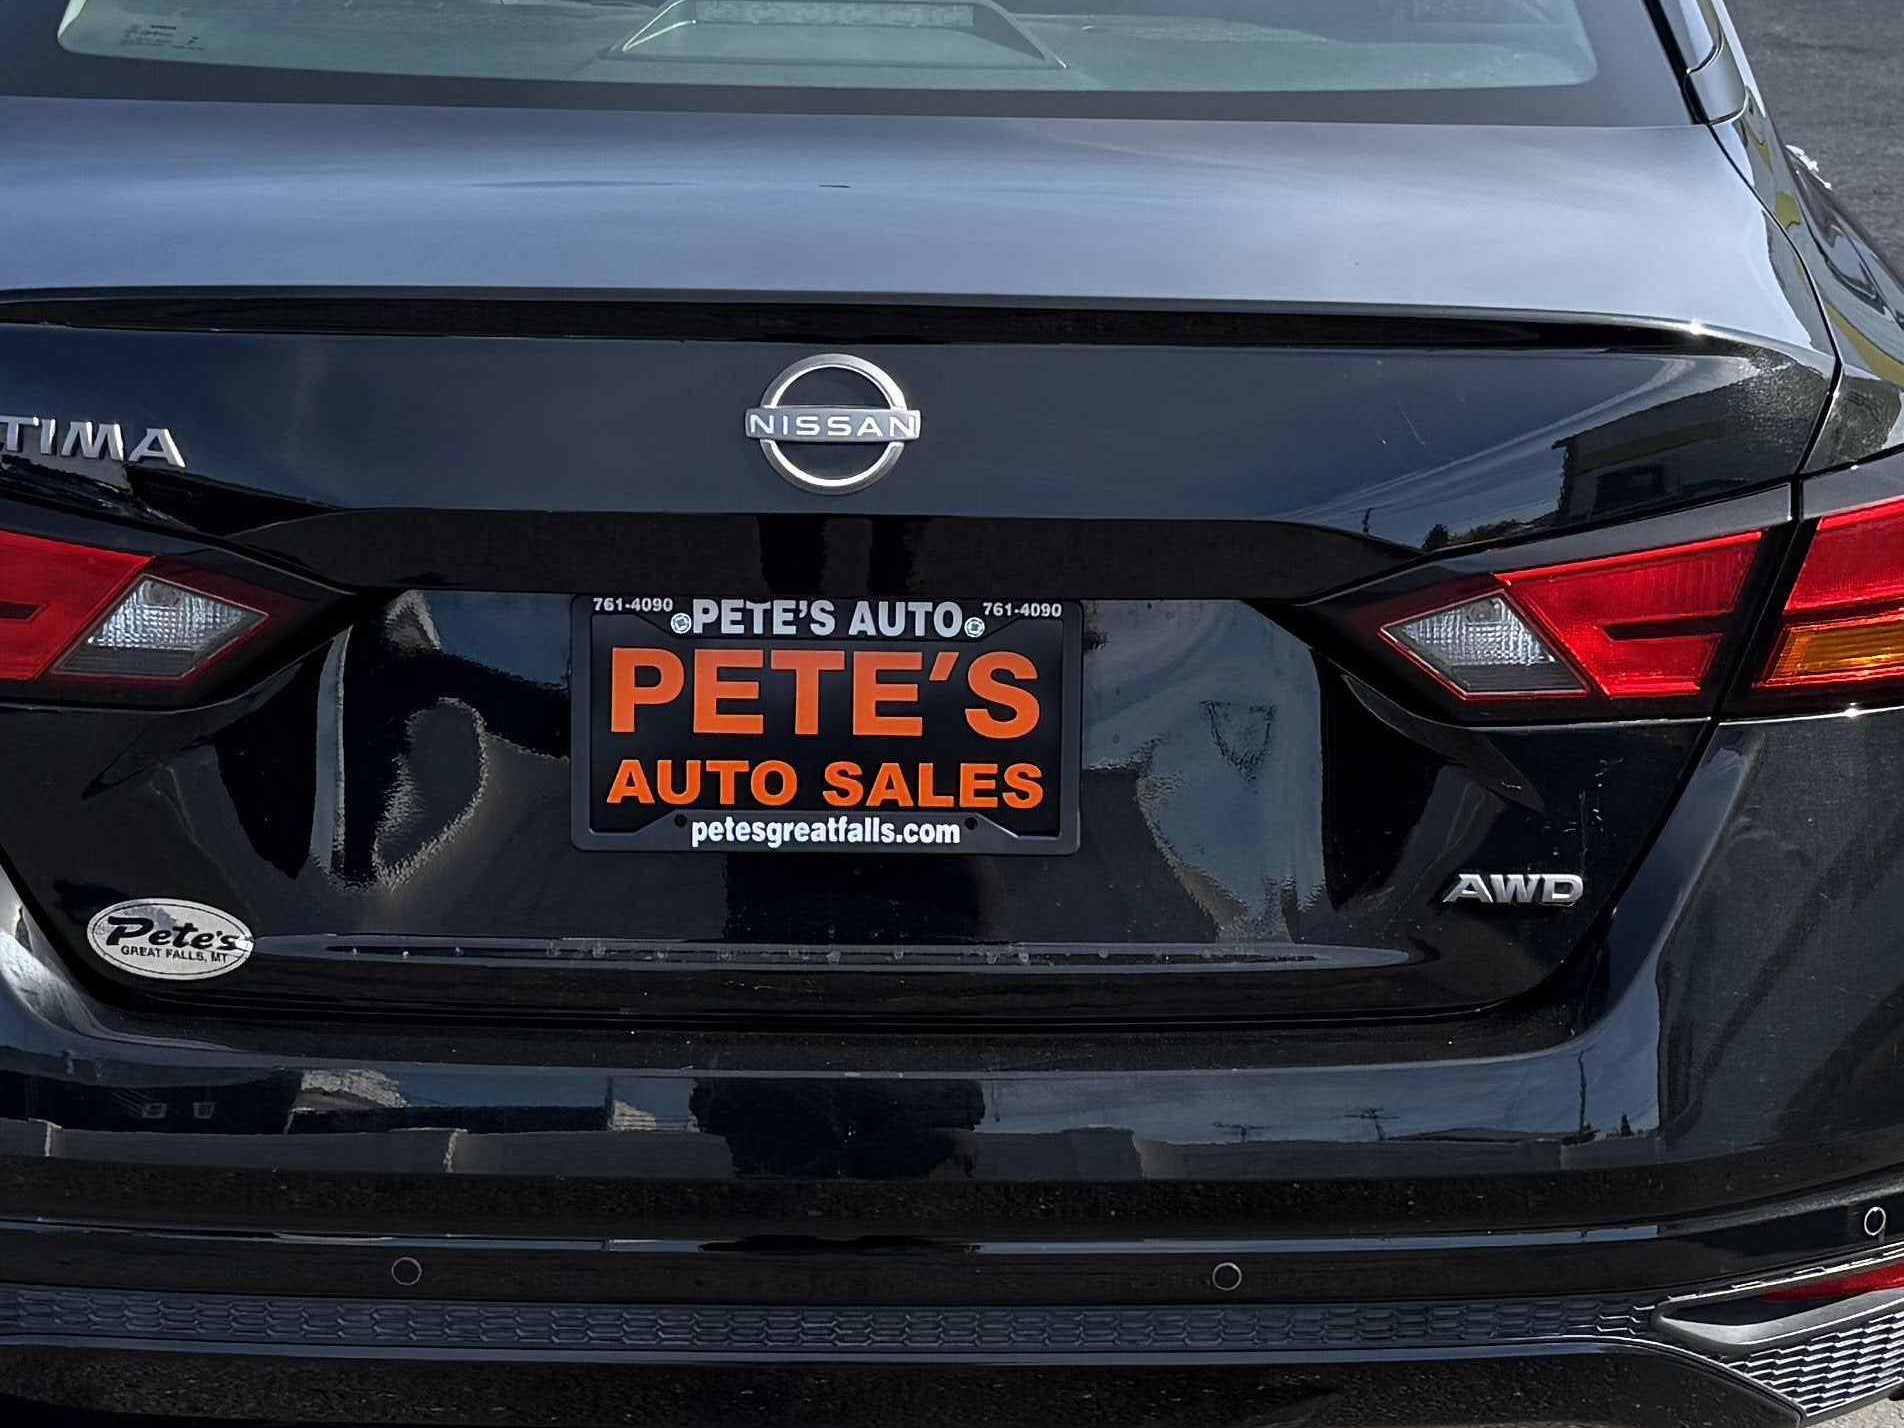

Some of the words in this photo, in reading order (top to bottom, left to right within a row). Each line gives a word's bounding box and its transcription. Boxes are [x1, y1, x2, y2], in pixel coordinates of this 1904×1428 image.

[749, 415, 917, 437] NISSAN
[593, 598, 674, 612] 761-4090
[693, 599, 836, 636] PETE'S
[848, 600, 963, 637] AUTO
[983, 602, 1063, 617] 761-4090
[611, 647, 1041, 740] PETE'S
[607, 759, 798, 806] AUTO
[822, 761, 1044, 809] SALES
[691, 816, 961, 849] petesgreatfalls.com
[1442, 874, 1583, 904] AWD
[106, 916, 240, 951] Pete's
[121, 945, 161, 959] GREAT
[165, 948, 208, 963] FALLS,
[211, 952, 229, 963] MT
